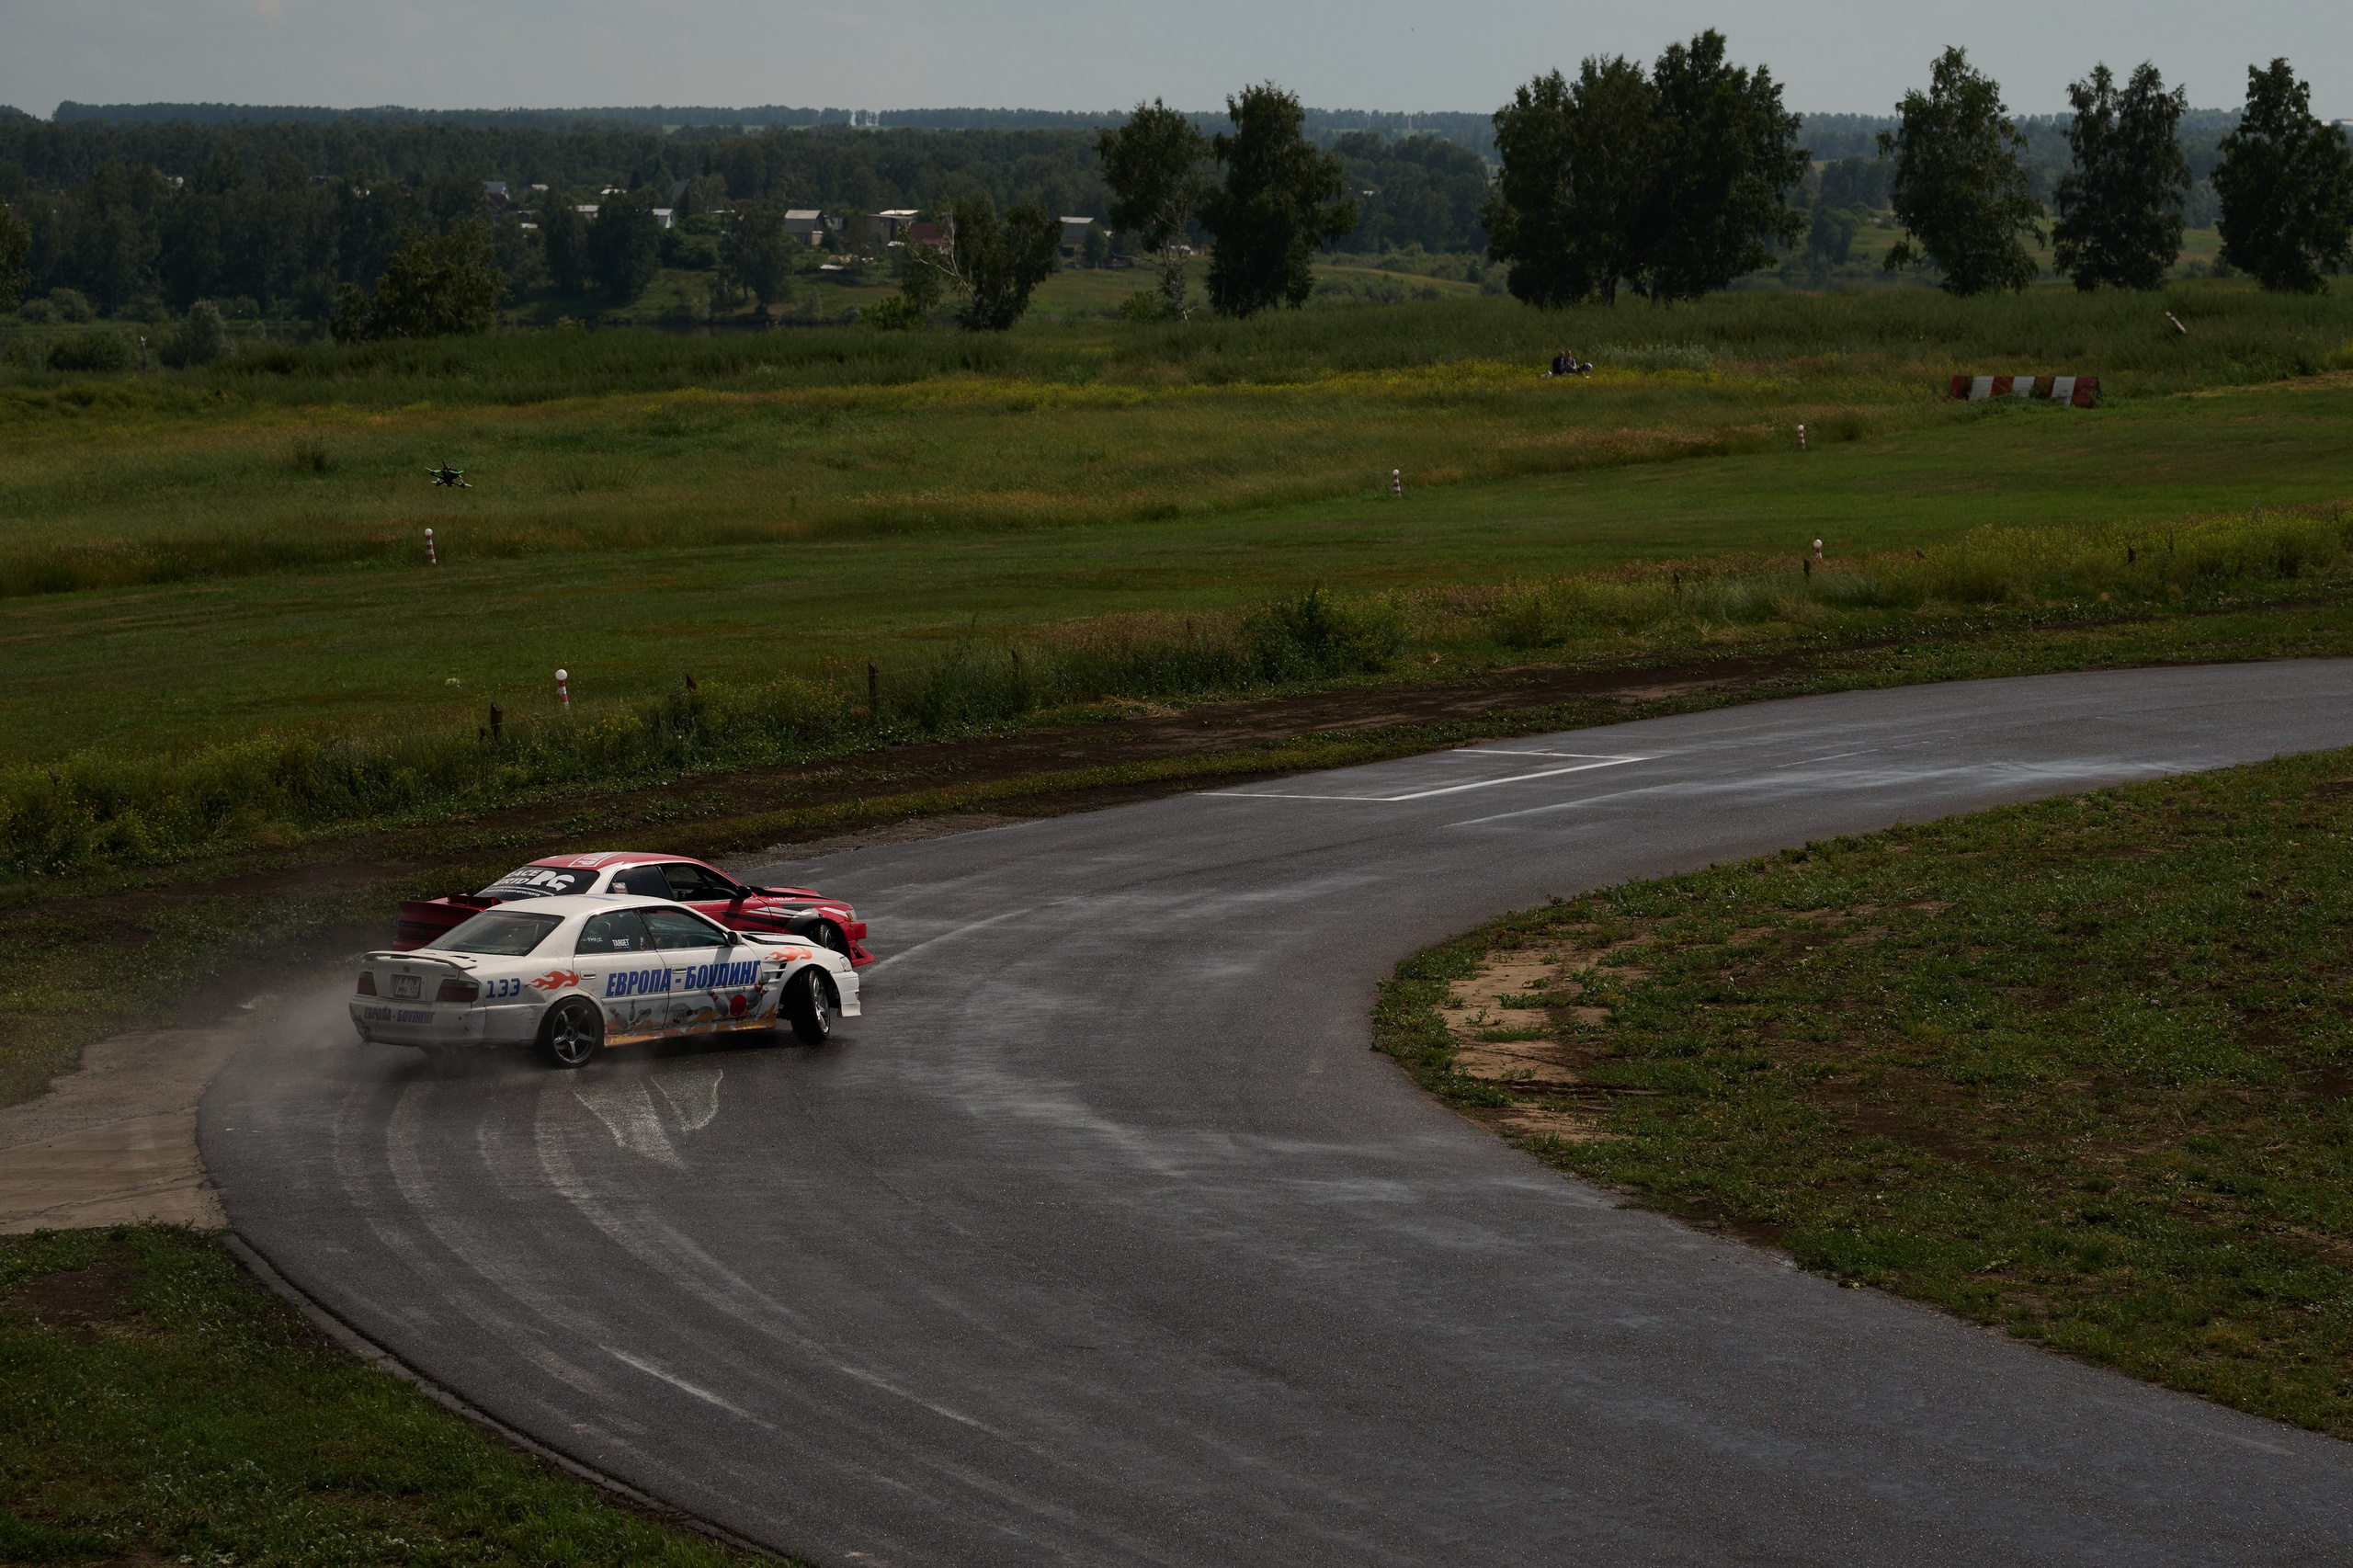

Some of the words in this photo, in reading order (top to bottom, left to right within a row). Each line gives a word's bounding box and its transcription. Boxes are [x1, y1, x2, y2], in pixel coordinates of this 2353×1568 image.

[612, 938, 630, 947] TARGET
[606, 968, 672, 997] ЕВРОПА
[684, 960, 761, 990] БОУЛИНГ
[485, 978, 521, 999] 133
[364, 1006, 392, 1021] ЕВРОПА
[396, 1009, 437, 1024] БОУЛИНГ
